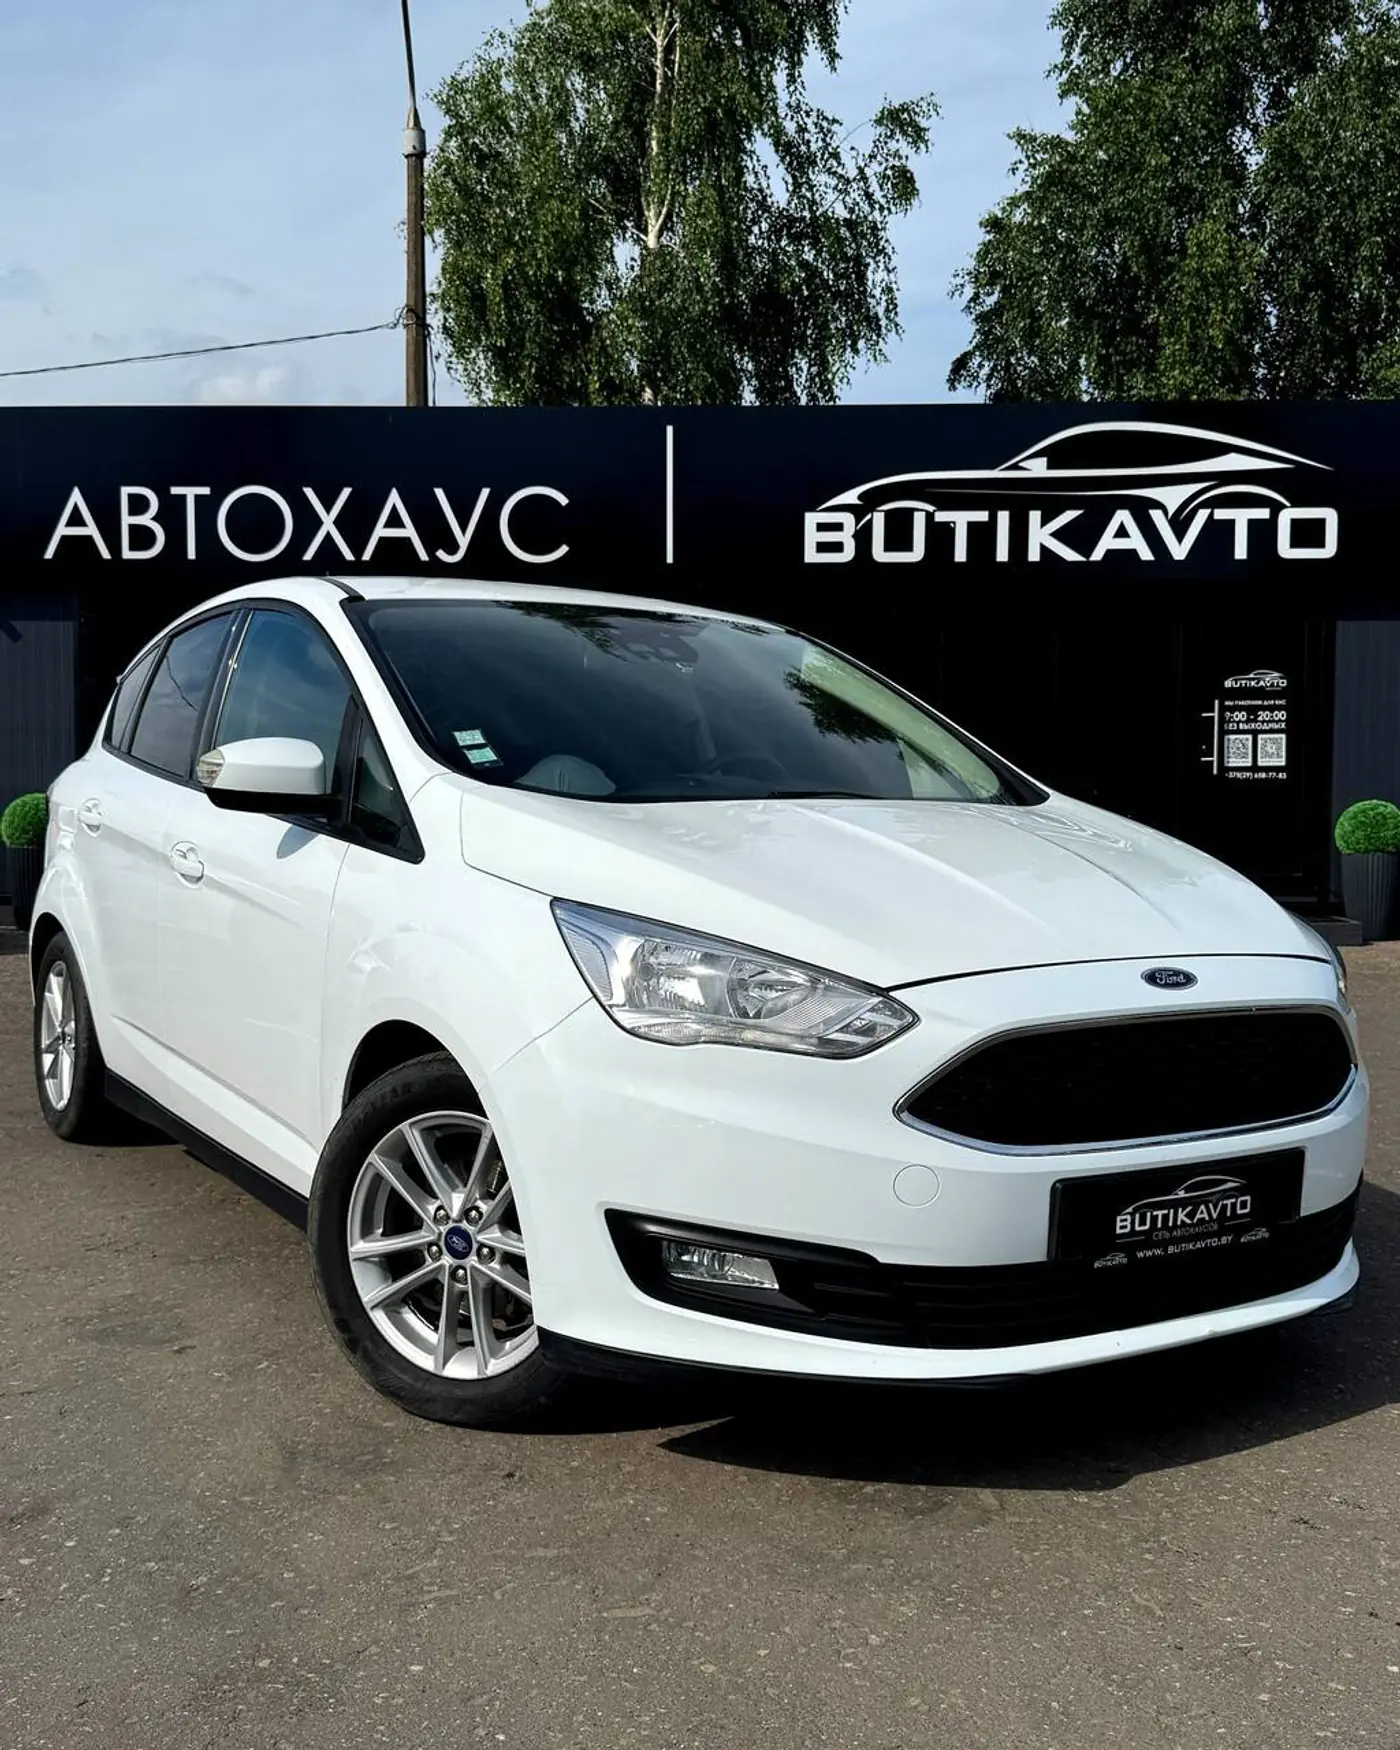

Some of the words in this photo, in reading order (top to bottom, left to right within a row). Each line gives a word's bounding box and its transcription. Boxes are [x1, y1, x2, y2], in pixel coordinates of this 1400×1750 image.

[43, 485, 570, 564] АВТОХАУС
[804, 507, 1338, 563] BUTIKAVTO
[1224, 679, 1287, 688] BUTIKAVTO
[1224, 711, 1247, 721] 9:00
[1257, 711, 1287, 721] 20:00
[1155, 970, 1187, 985] Ford
[1115, 1195, 1251, 1234] BUTIKAVTO
